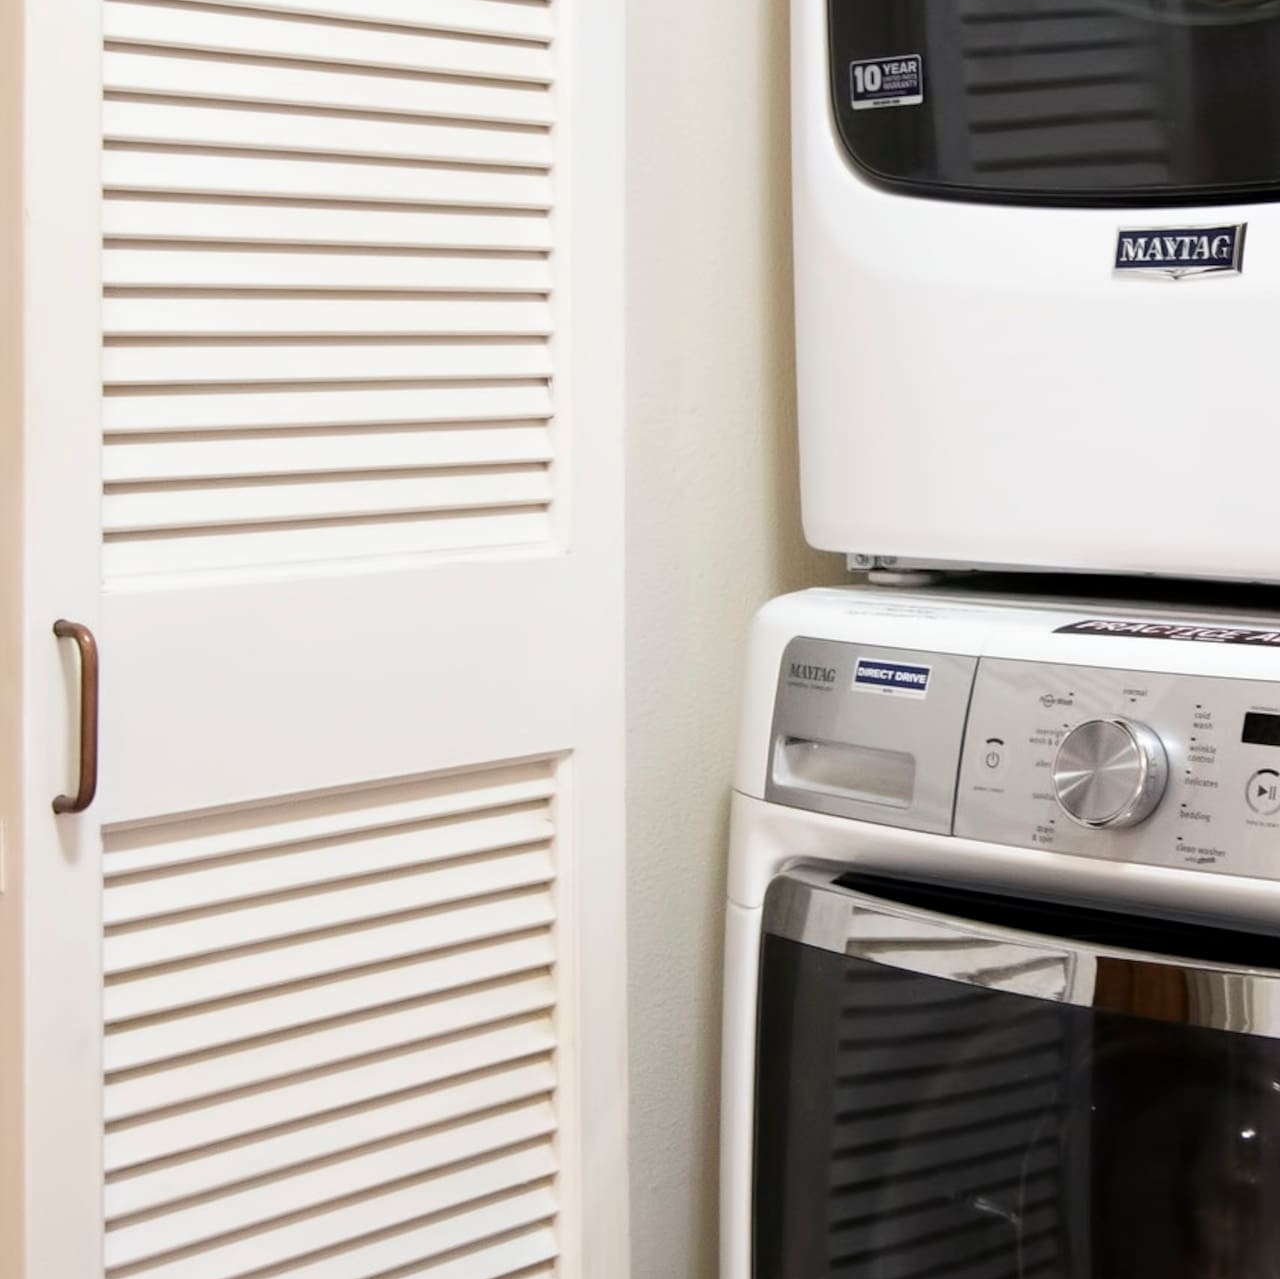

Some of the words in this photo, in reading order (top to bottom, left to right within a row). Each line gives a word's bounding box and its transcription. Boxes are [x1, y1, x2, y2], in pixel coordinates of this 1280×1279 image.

[854, 65, 882, 93] 10
[882, 61, 917, 75] YEAR
[1120, 235, 1231, 261] MAYTAG
[1075, 621, 1250, 639] PRACTICE
[789, 663, 836, 684] MAYTAG
[858, 667, 893, 680] DIRECT
[894, 671, 927, 685] DRIVE
[1194, 711, 1212, 720] cold
[1189, 745, 1217, 755] wrinkle
[1187, 754, 1215, 764] control
[1184, 777, 1219, 788] delicates
[1179, 809, 1211, 822] bedding
[1176, 843, 1196, 853] clean
[1198, 847, 1226, 857] washer
